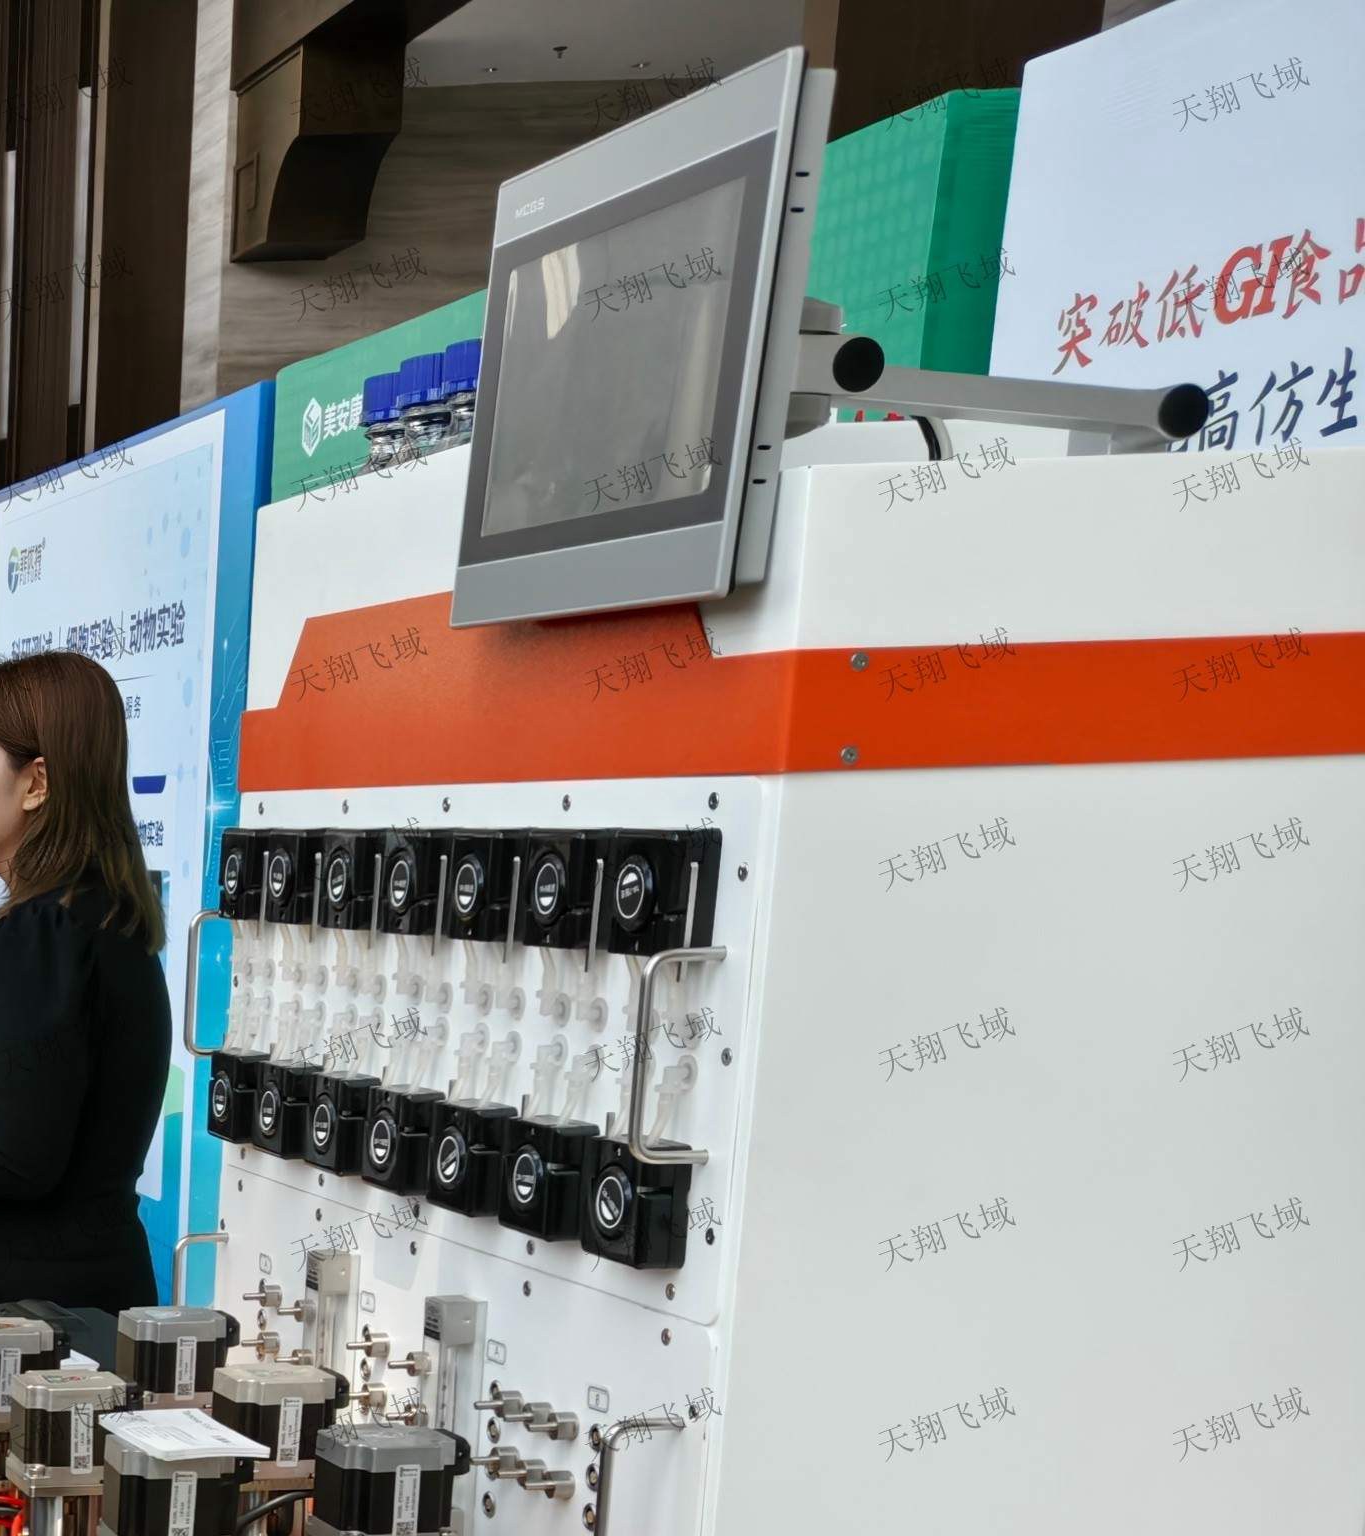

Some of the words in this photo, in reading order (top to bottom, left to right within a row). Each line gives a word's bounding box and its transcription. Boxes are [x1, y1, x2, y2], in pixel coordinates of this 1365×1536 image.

[323, 393, 363, 440] 美安康
[1166, 346, 1359, 453] 高仿生
[130, 600, 186, 658] 动物实验
